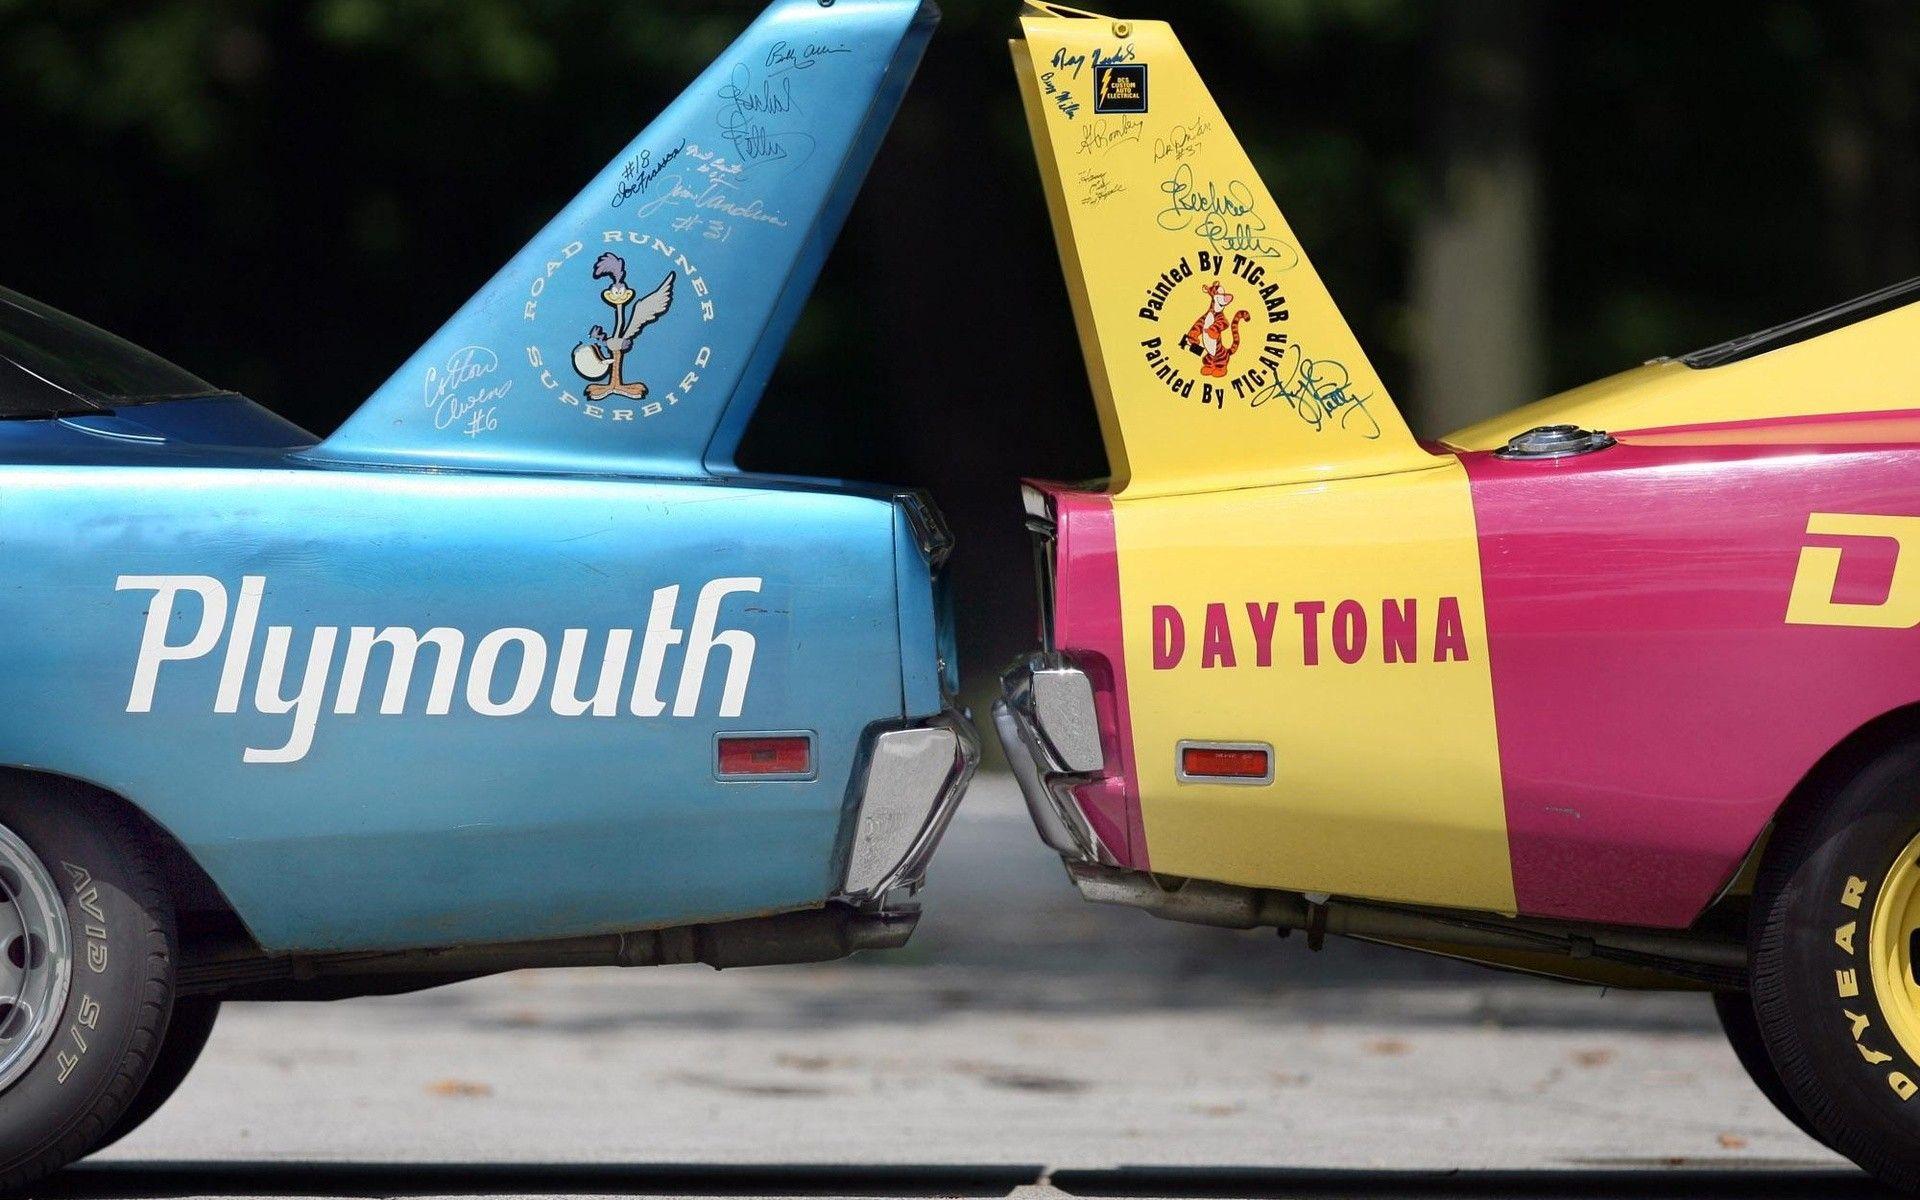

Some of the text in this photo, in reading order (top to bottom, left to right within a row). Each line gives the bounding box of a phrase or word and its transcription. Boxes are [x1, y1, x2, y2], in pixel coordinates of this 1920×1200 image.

[524, 230, 714, 322] ROAD RUNNER
[1139, 251, 1289, 323] Painted By TIG-AAR
[526, 345, 711, 421] SUPERBIRD
[1141, 332, 1287, 409] Painted By TIG-AAR
[115, 575, 762, 763] Plymouth
[1152, 597, 1469, 670] DAYTONA
[61, 860, 108, 974] AVID
